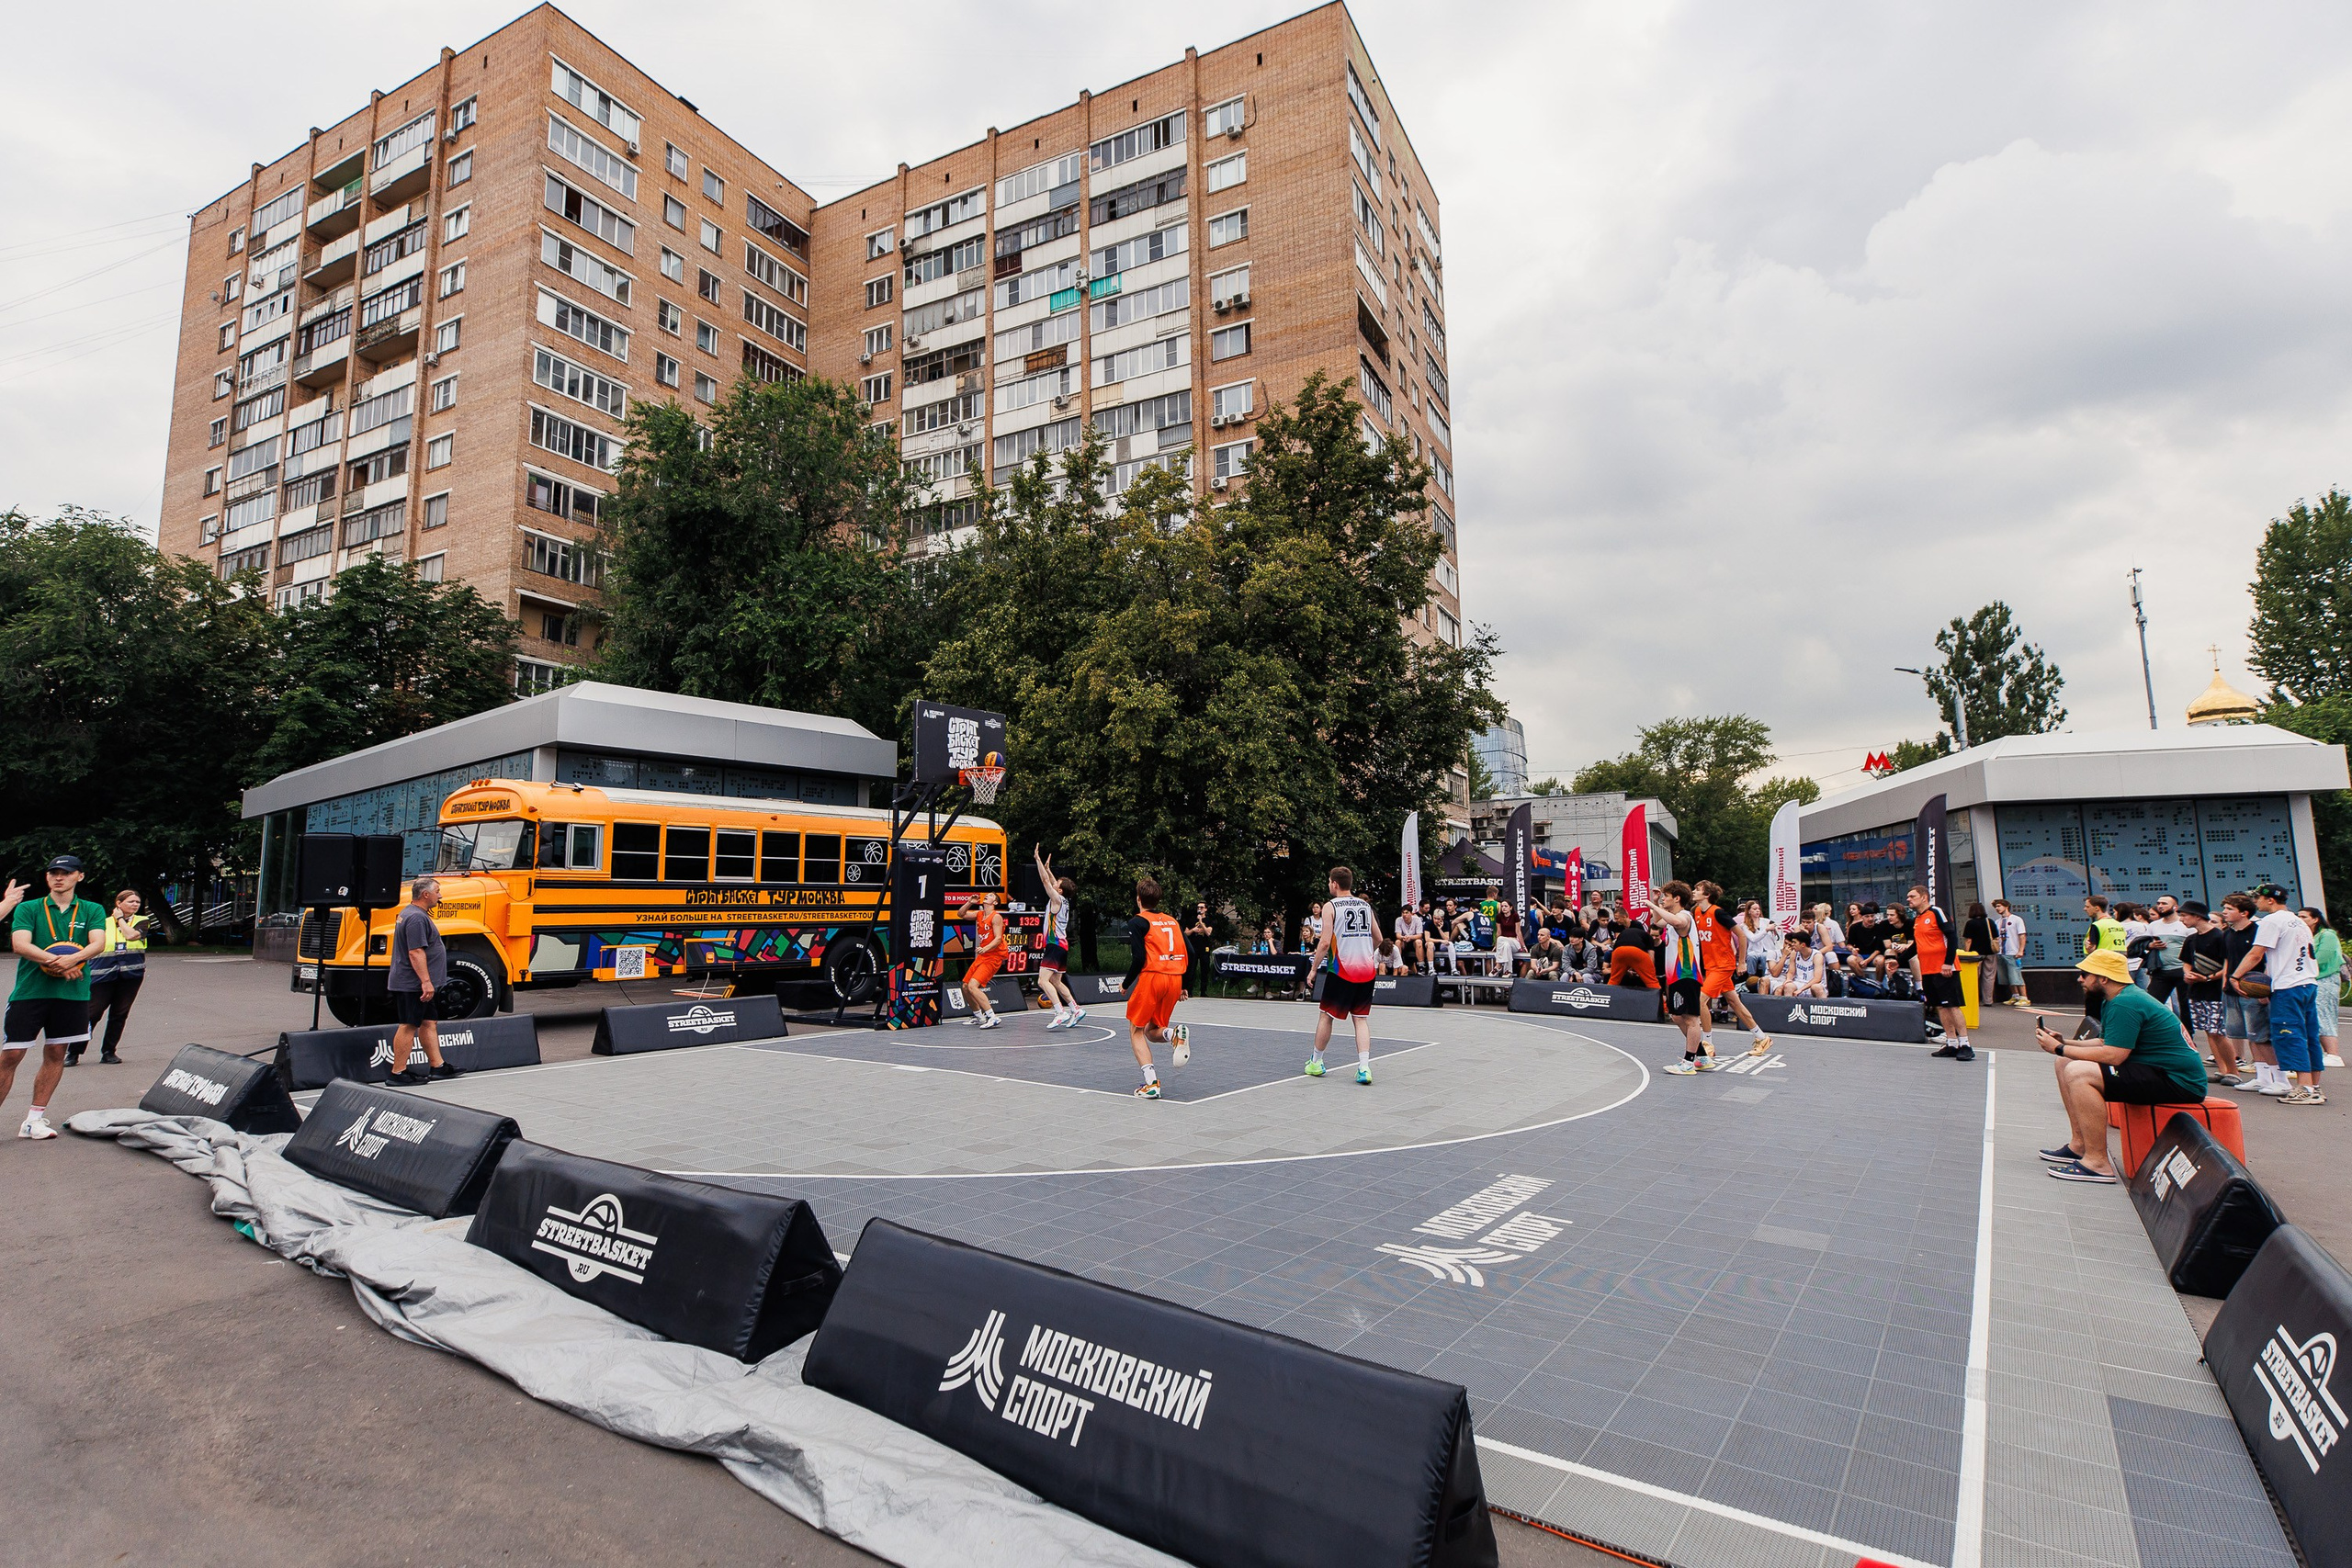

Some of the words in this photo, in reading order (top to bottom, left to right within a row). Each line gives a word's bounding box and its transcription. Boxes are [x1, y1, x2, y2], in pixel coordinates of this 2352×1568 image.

[949, 717, 978, 735] СТРИТ
[948, 748, 978, 761] ТУР
[918, 874, 927, 899] 1
[1516, 829, 1525, 927] STREETBASKET
[1630, 849, 1640, 909] МОСКОВСКИЙ
[768, 890, 799, 904] ТУР
[799, 891, 845, 905] МОСКВА
[1785, 881, 1798, 911] СПОРТ
[437, 901, 481, 910] МОСКОВСКИЙ
[437, 910, 458, 919] СПОРТ
[1482, 906, 1494, 917] 23
[636, 912, 668, 921] УЗНАЙ
[670, 914, 708, 922] БОЛЬШЕ
[1020, 917, 1040, 926] 1329
[1344, 908, 1370, 932] 21
[1479, 916, 1490, 927] 69
[1706, 917, 1712, 927] 9
[1161, 927, 1174, 952] 7
[1007, 952, 1027, 972] 09
[1220, 962, 1296, 976] STREETBASKET
[1374, 980, 1396, 989] ОВСКИЙ
[1552, 994, 1611, 1005] STREETBASKET
[1810, 1005, 1867, 1019] МОСКОВСКИЙ
[1810, 1015, 1838, 1026] СПОРТ
[668, 1015, 735, 1028] STREETBASKET
[370, 1110, 437, 1145] МОСКОВСКИЙ
[354, 1133, 390, 1160] СПОРТ
[1411, 1173, 1557, 1240] МОСКОВСКИЙ
[1477, 1211, 1574, 1252] СПОРТ
[536, 1217, 654, 1270] STREETBASKET
[1020, 1324, 1213, 1430] МОСКОВСКИЙ
[2260, 1337, 2339, 1458] STREETBASKET
[1001, 1374, 1095, 1447] СПОРТ
